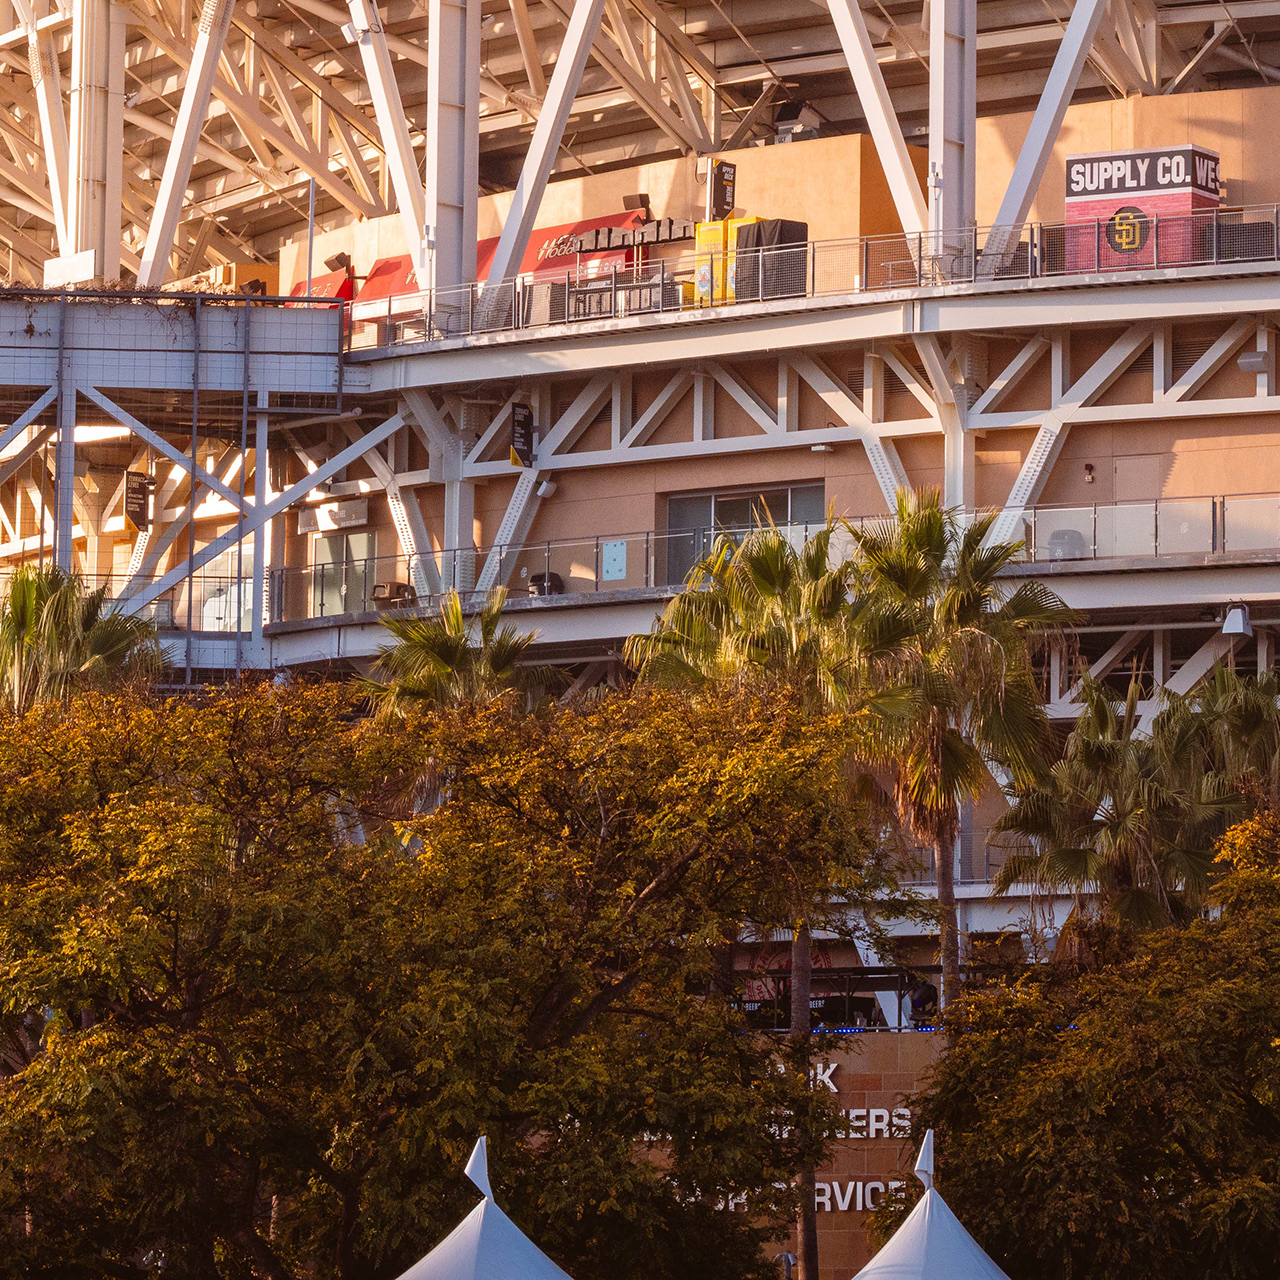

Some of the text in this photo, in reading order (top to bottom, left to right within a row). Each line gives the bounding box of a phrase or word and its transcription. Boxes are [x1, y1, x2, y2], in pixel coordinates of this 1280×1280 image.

[1070, 155, 1191, 192] SUPPLY CO.
[771, 1181, 907, 1212] RVICE
